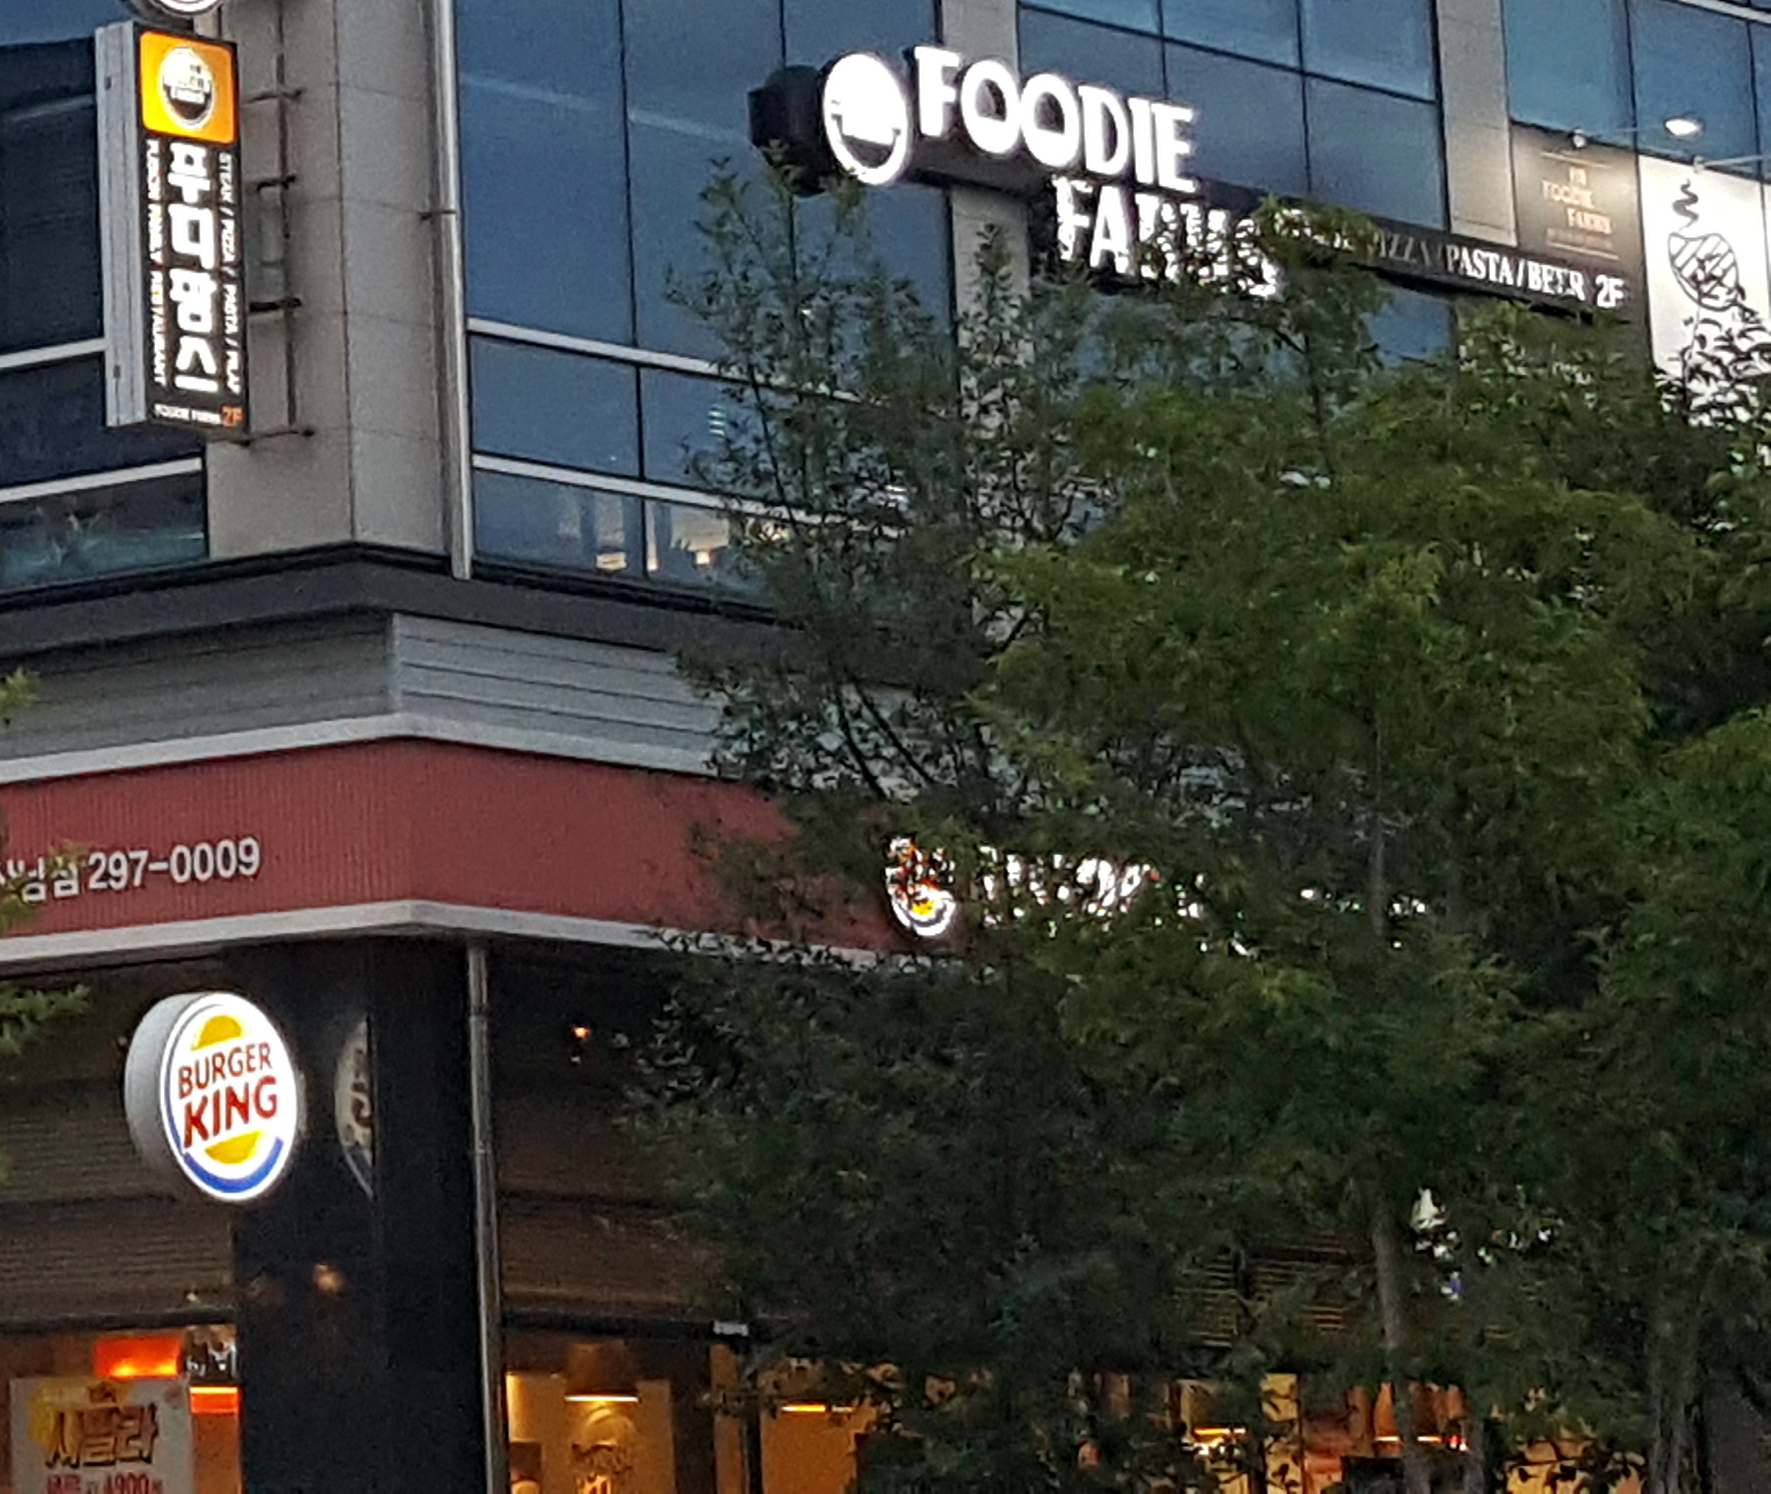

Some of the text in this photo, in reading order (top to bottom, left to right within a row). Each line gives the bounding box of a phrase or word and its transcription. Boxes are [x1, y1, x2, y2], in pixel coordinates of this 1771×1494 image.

[912, 45, 1201, 195] FOODIE
[87, 835, 261, 892] 297-0009
[176, 1042, 274, 1100] BURGER
[181, 1076, 278, 1151] KING
